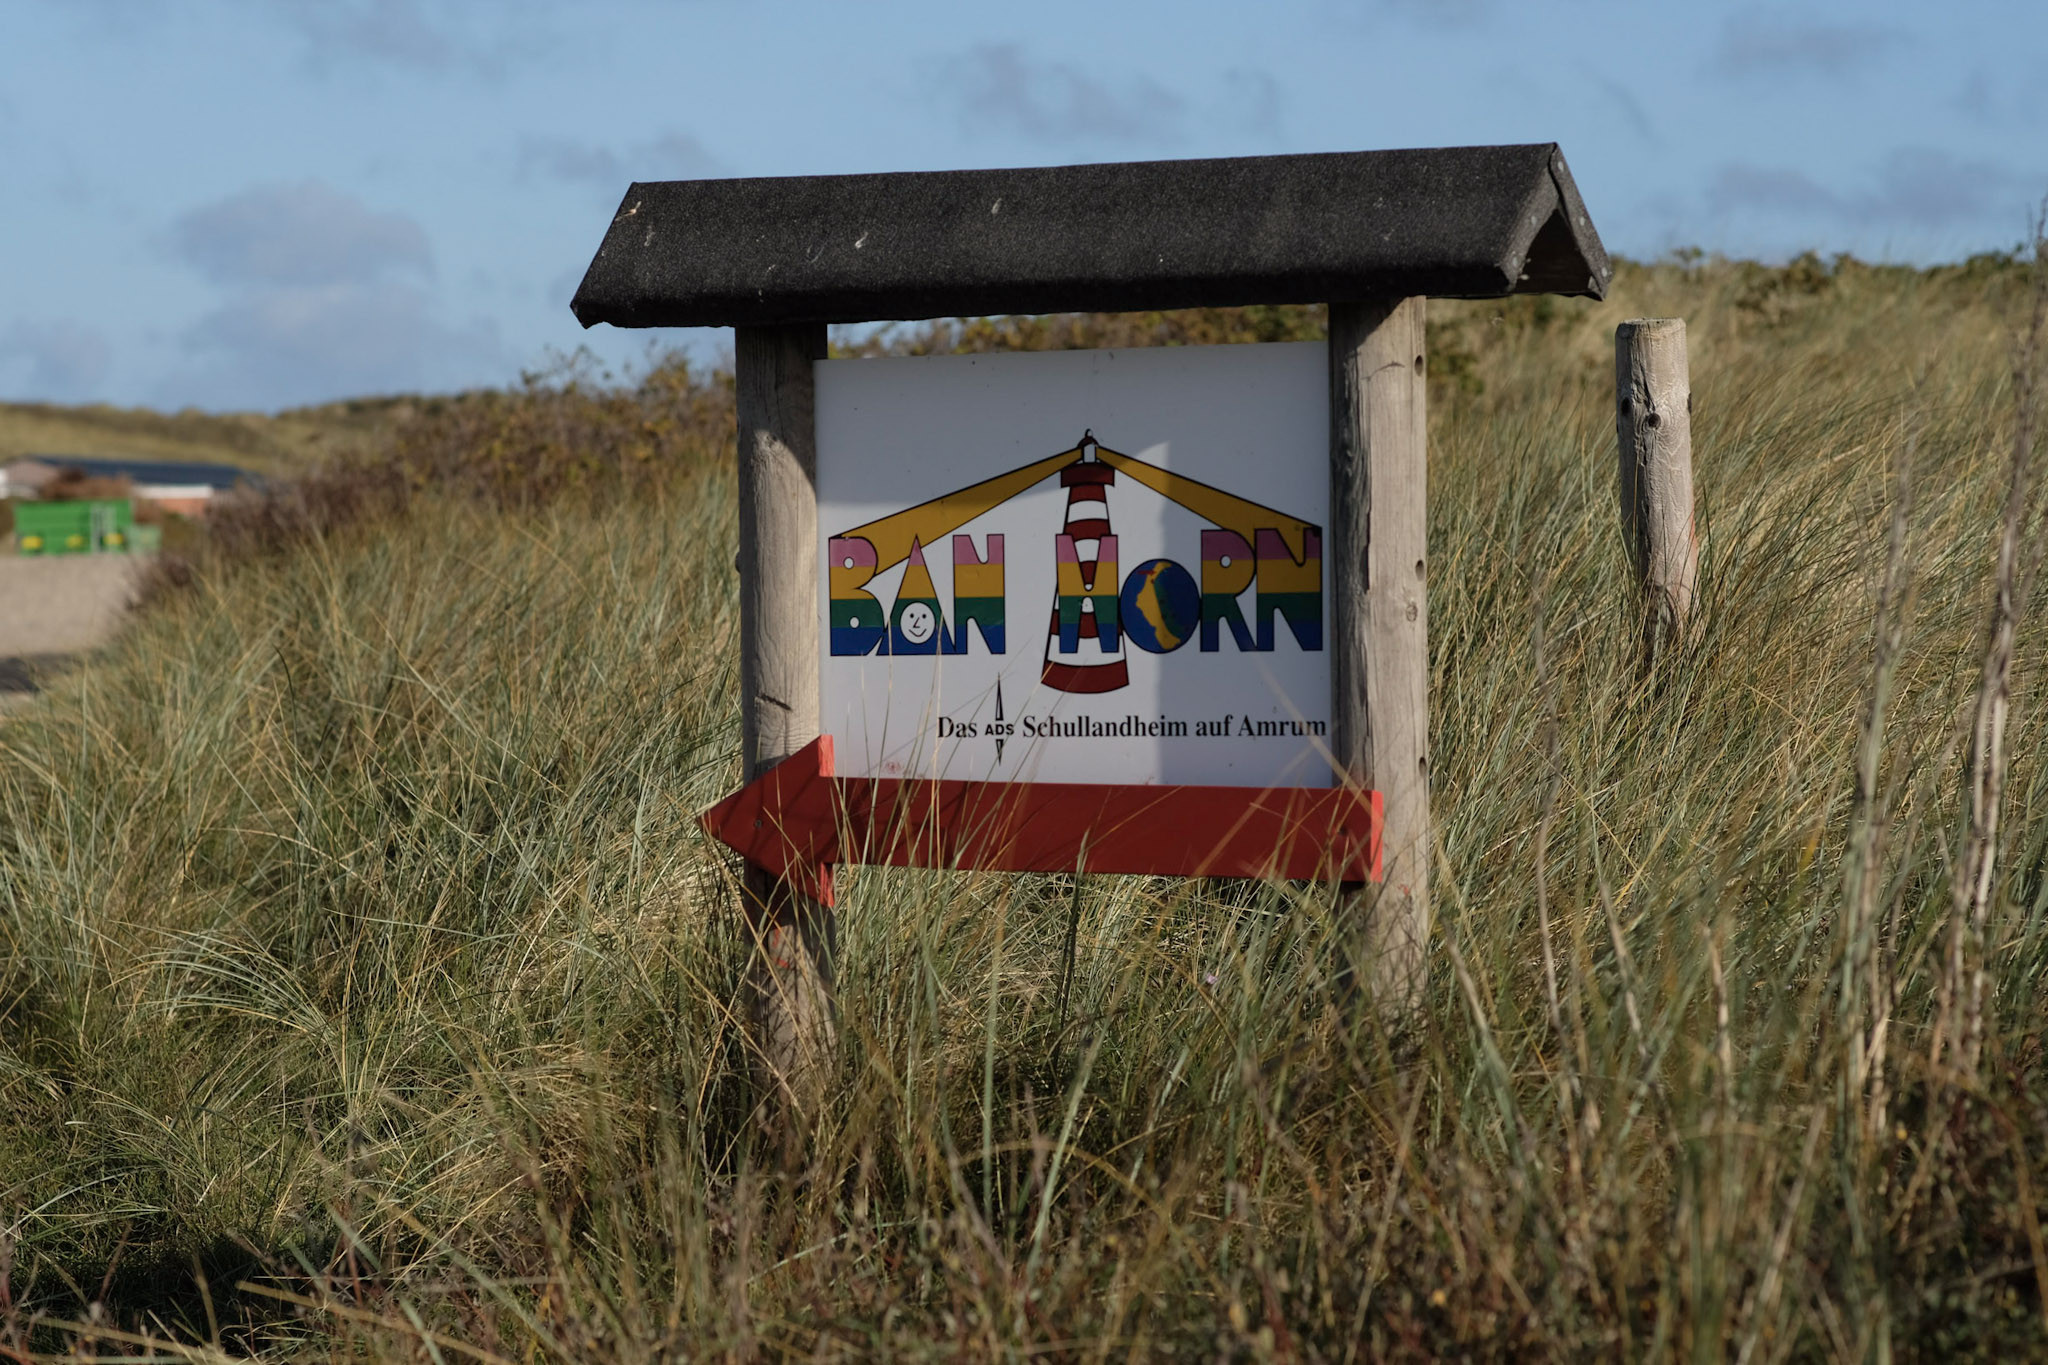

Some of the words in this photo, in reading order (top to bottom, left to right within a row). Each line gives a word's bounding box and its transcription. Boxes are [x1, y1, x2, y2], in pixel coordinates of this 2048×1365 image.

[829, 534, 1006, 656] BAN
[1056, 526, 1324, 654] HORN
[938, 716, 978, 738] Das
[985, 724, 1015, 736] ADS
[1023, 714, 1188, 738] Schullandheim
[1195, 714, 1234, 737] auf
[1238, 715, 1327, 737] Amrum
